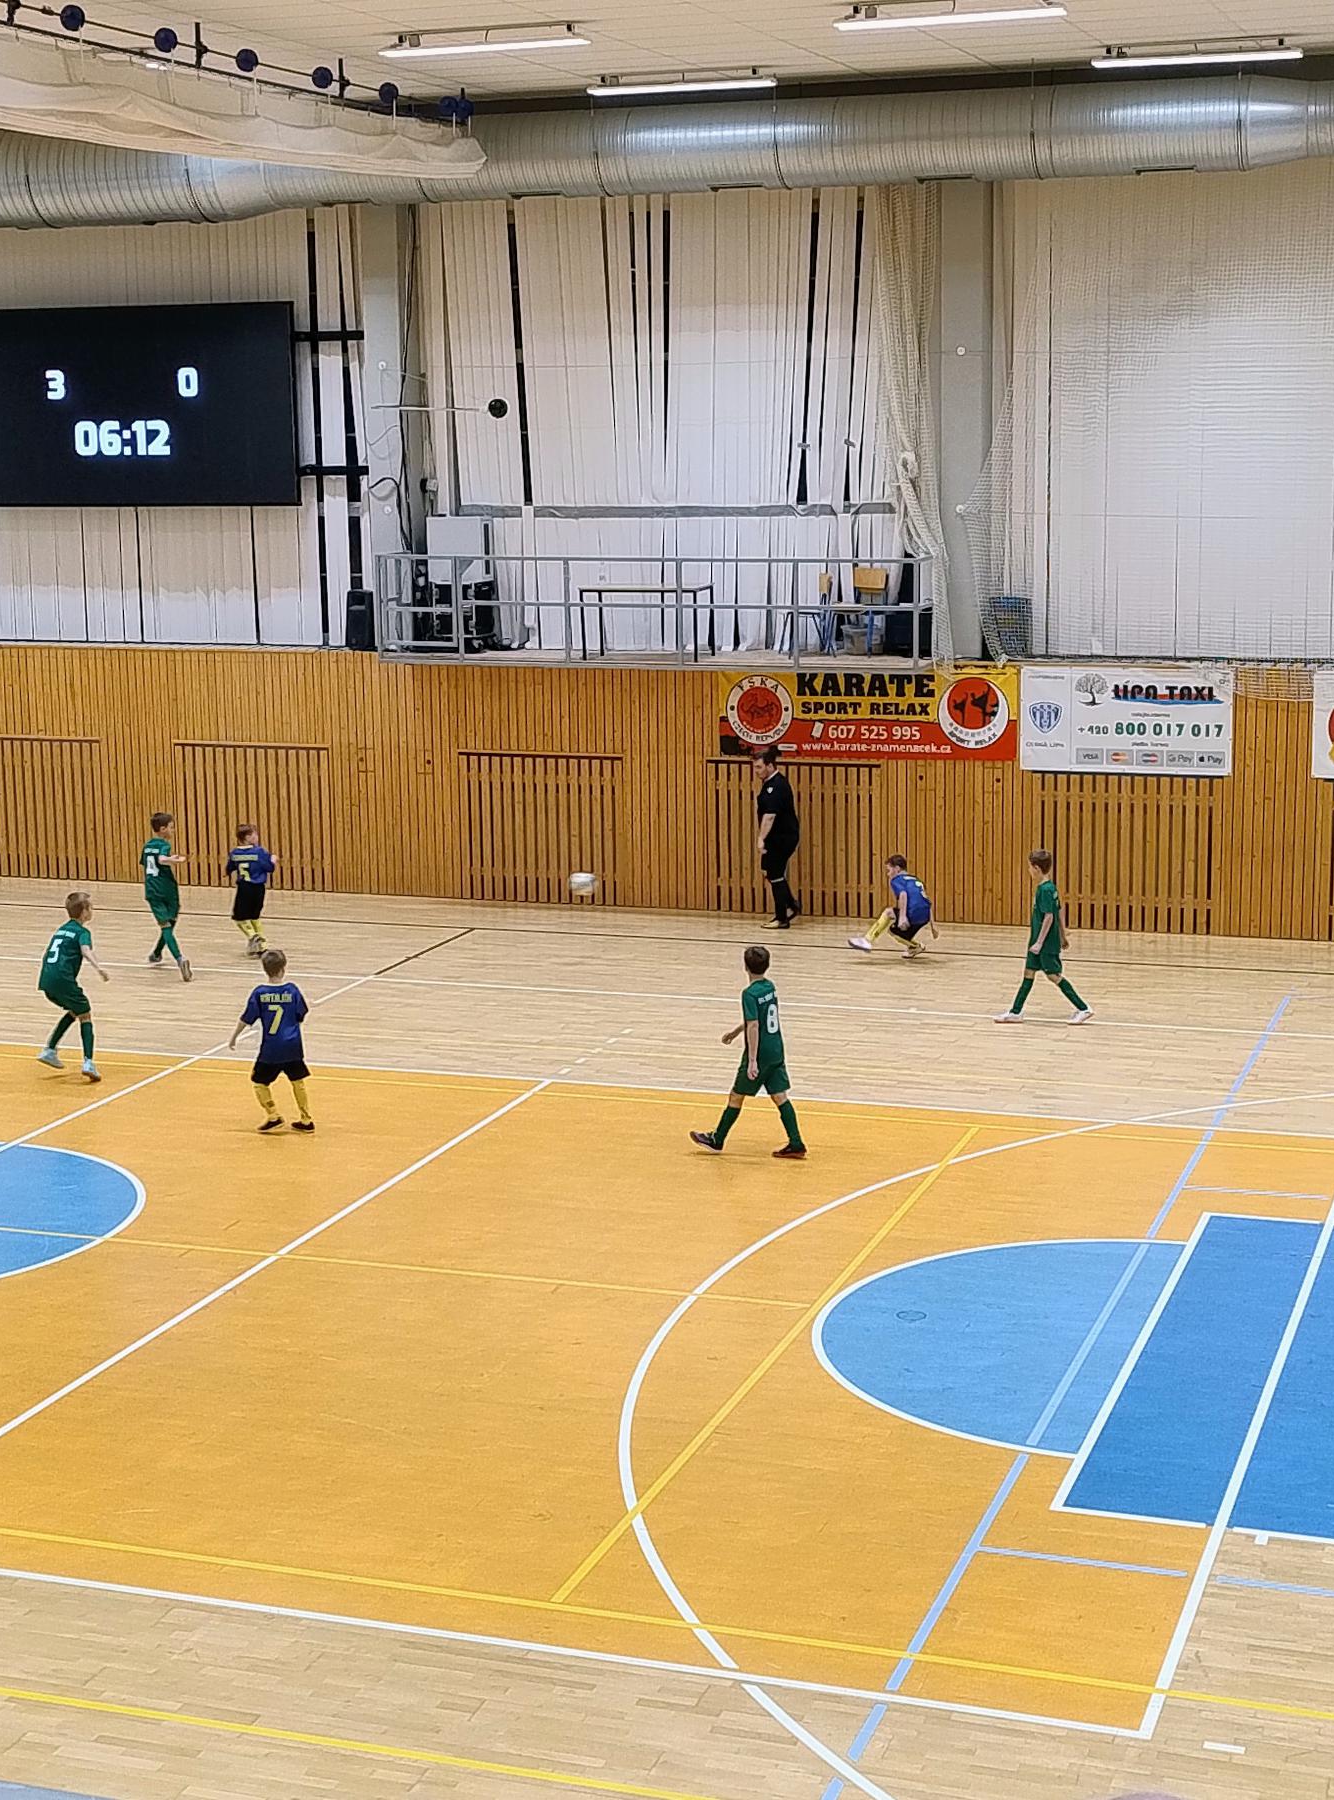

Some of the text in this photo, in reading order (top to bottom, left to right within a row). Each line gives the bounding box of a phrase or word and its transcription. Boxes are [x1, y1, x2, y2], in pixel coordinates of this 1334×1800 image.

[45, 369, 65, 400] 3
[177, 367, 198, 397] 0
[74, 419, 171, 456] 06:12
[796, 673, 935, 697] KARATE
[1165, 685, 1216, 701] TAXI
[801, 701, 930, 716] SPORT RELAX
[828, 725, 921, 740] 607 525 995
[1115, 722, 1147, 736] 800
[1153, 723, 1185, 737] 017
[1191, 724, 1224, 738] 017
[46, 938, 63, 964] 5
[268, 1004, 284, 1035] 7
[766, 1003, 779, 1034] 8
